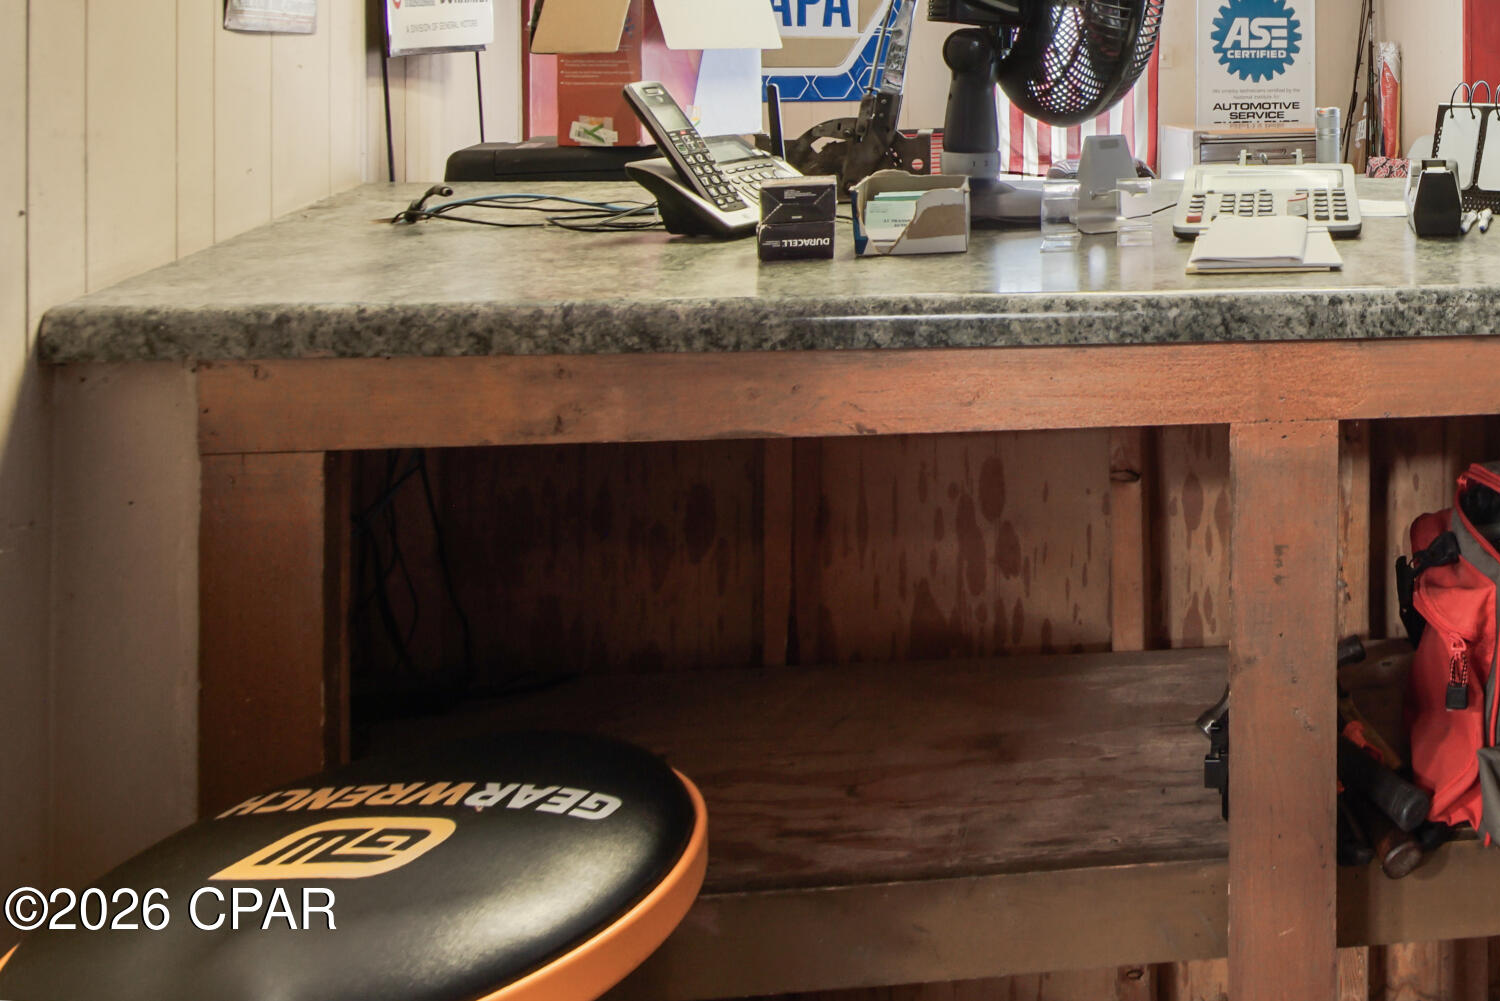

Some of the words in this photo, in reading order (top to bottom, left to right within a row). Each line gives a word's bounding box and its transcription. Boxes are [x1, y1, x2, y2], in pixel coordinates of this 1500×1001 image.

[1221, 17, 1288, 48] ASE
[1226, 49, 1287, 59] CERTIFIED
[1212, 101, 1301, 111] AUTOMOTIVE
[1229, 111, 1285, 120] SERVICE
[782, 237, 830, 247] DURACELL
